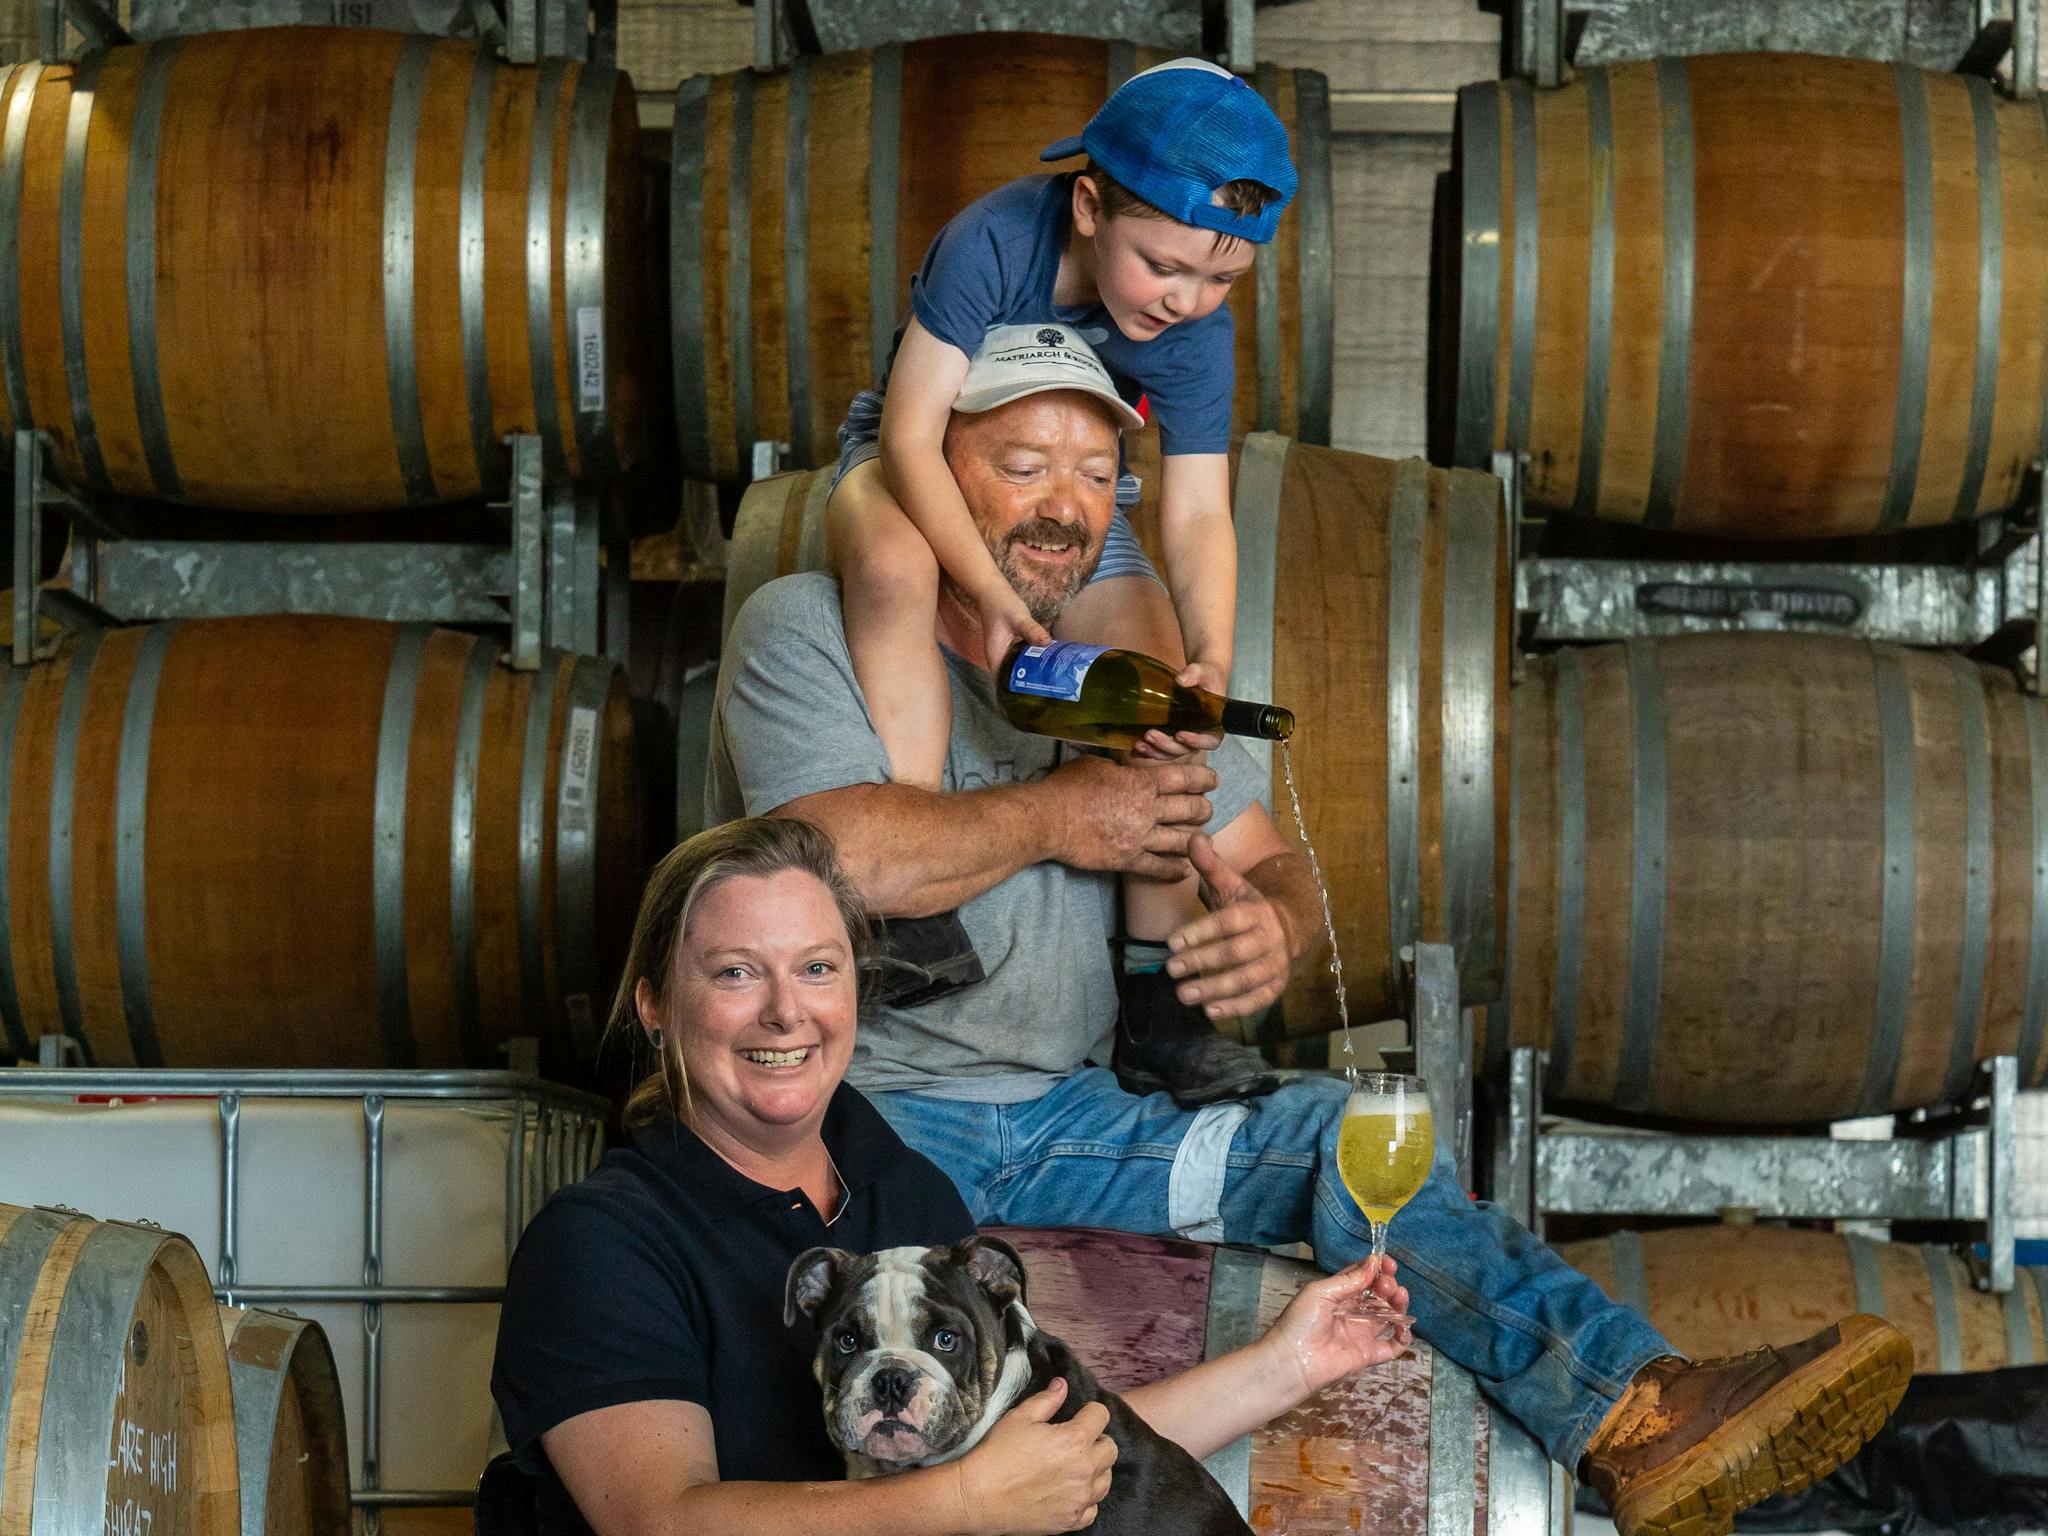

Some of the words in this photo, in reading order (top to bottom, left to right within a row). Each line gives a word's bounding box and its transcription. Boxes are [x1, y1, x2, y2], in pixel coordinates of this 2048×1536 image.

[994, 350, 1060, 363] MATRIARCH
[1064, 351, 1072, 360] &
[150, 1430, 178, 1497] HIGH
